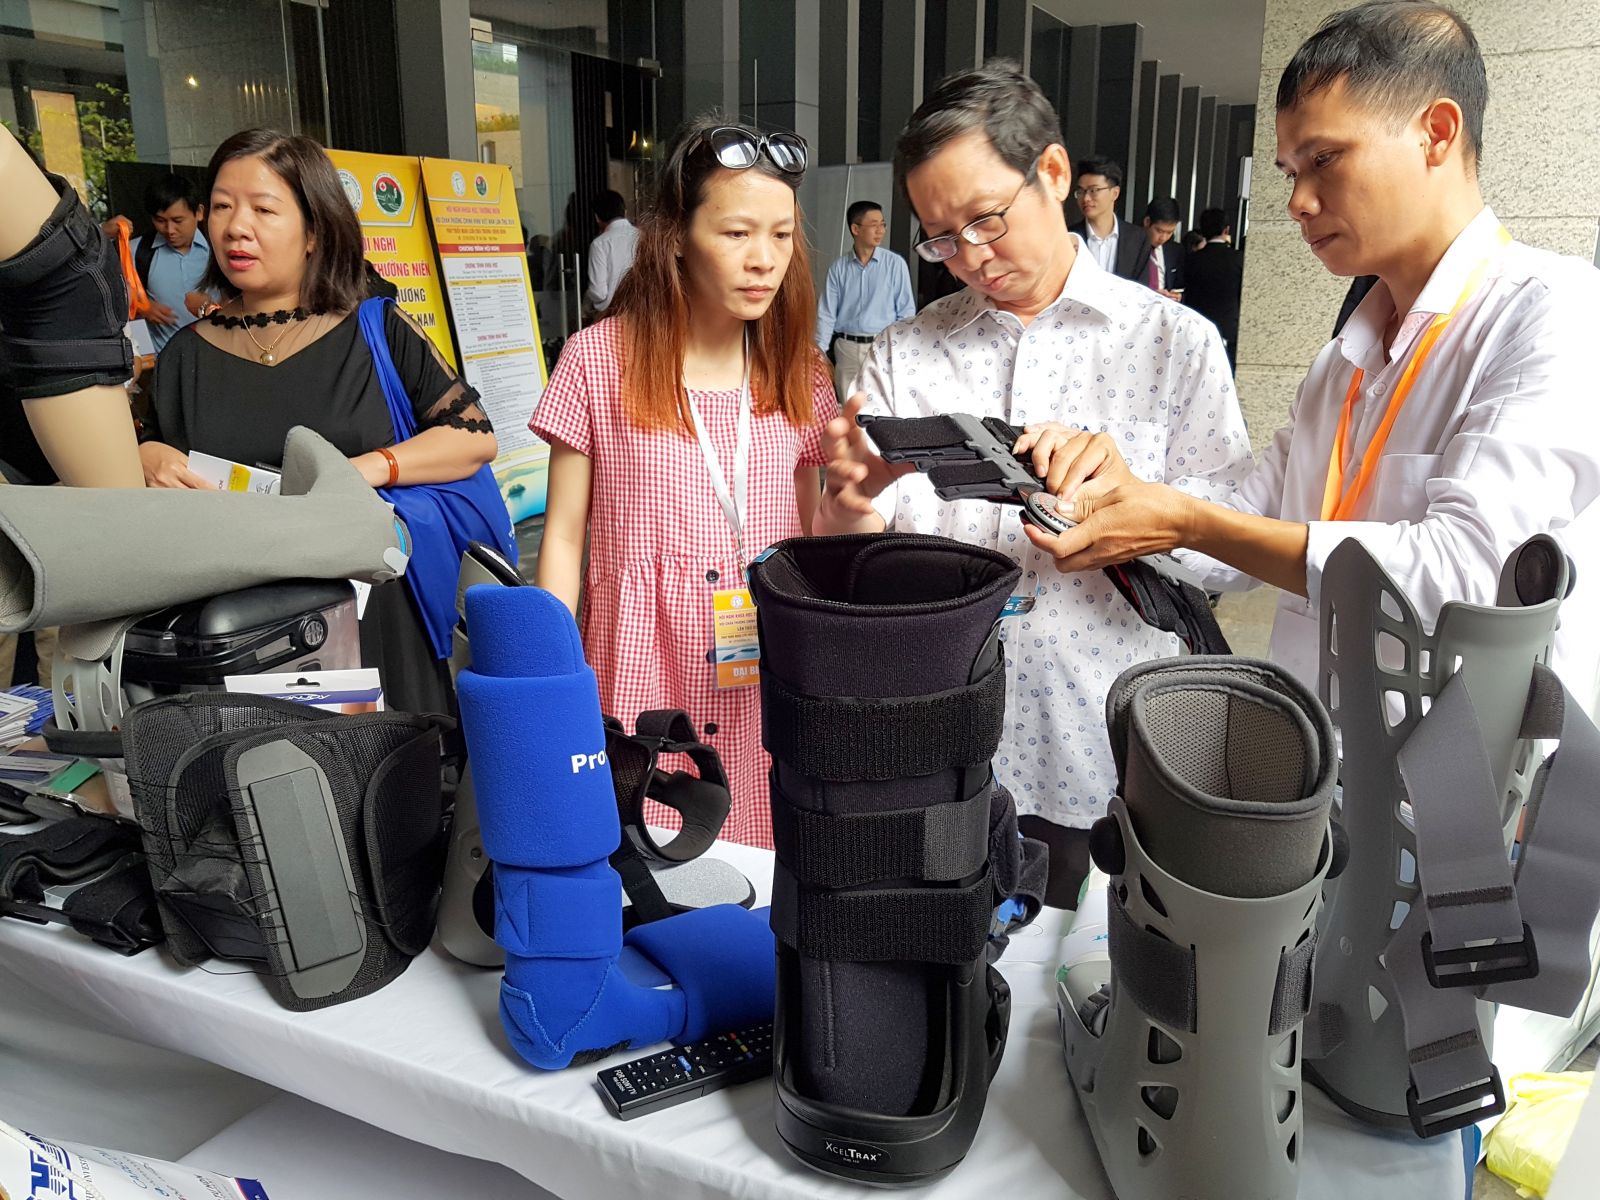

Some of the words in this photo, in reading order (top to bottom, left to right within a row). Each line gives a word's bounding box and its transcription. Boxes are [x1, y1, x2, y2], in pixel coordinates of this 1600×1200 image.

[373, 237, 397, 255] NGHỊ
[412, 260, 431, 276] NIÊN
[417, 312, 436, 326] NAM
[620, 1077, 634, 1089] SONY
